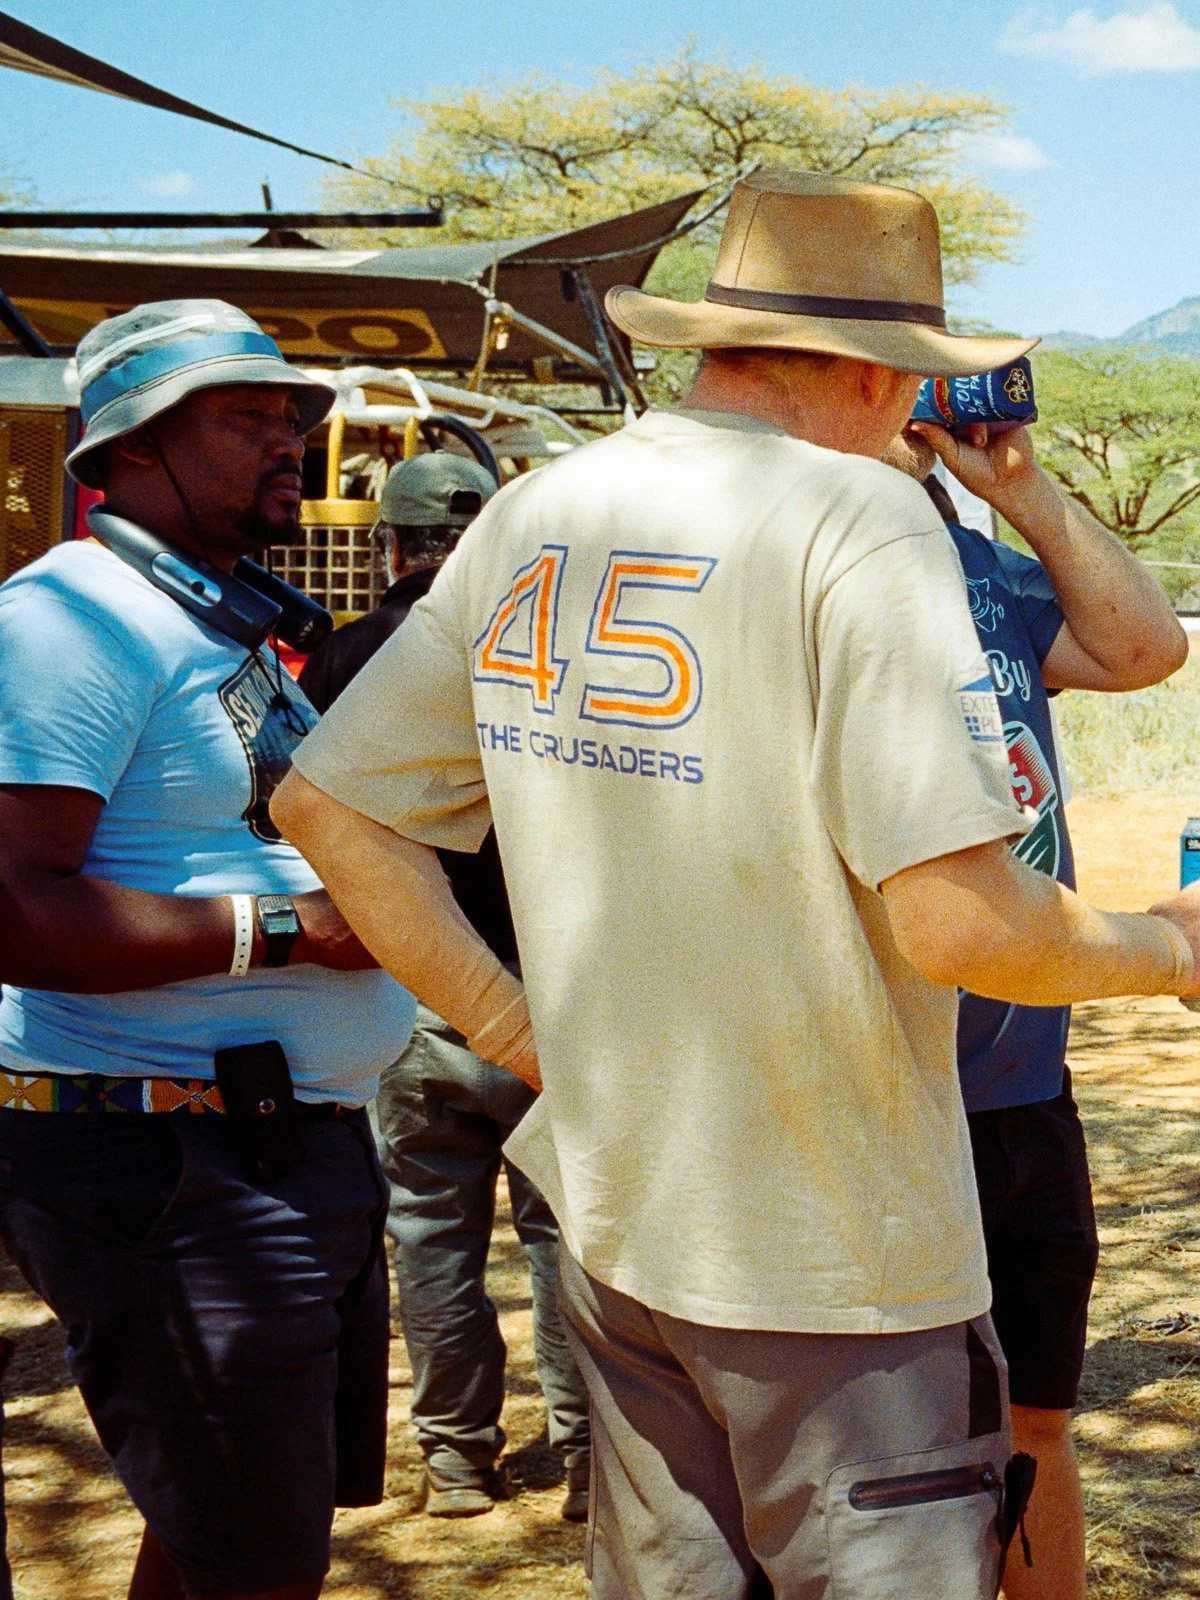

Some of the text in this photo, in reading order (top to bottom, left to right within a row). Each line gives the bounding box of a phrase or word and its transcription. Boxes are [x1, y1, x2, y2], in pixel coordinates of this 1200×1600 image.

[472, 544, 718, 730] 45
[983, 649, 1031, 701] By
[477, 722, 704, 785] THE CRUSADERS
